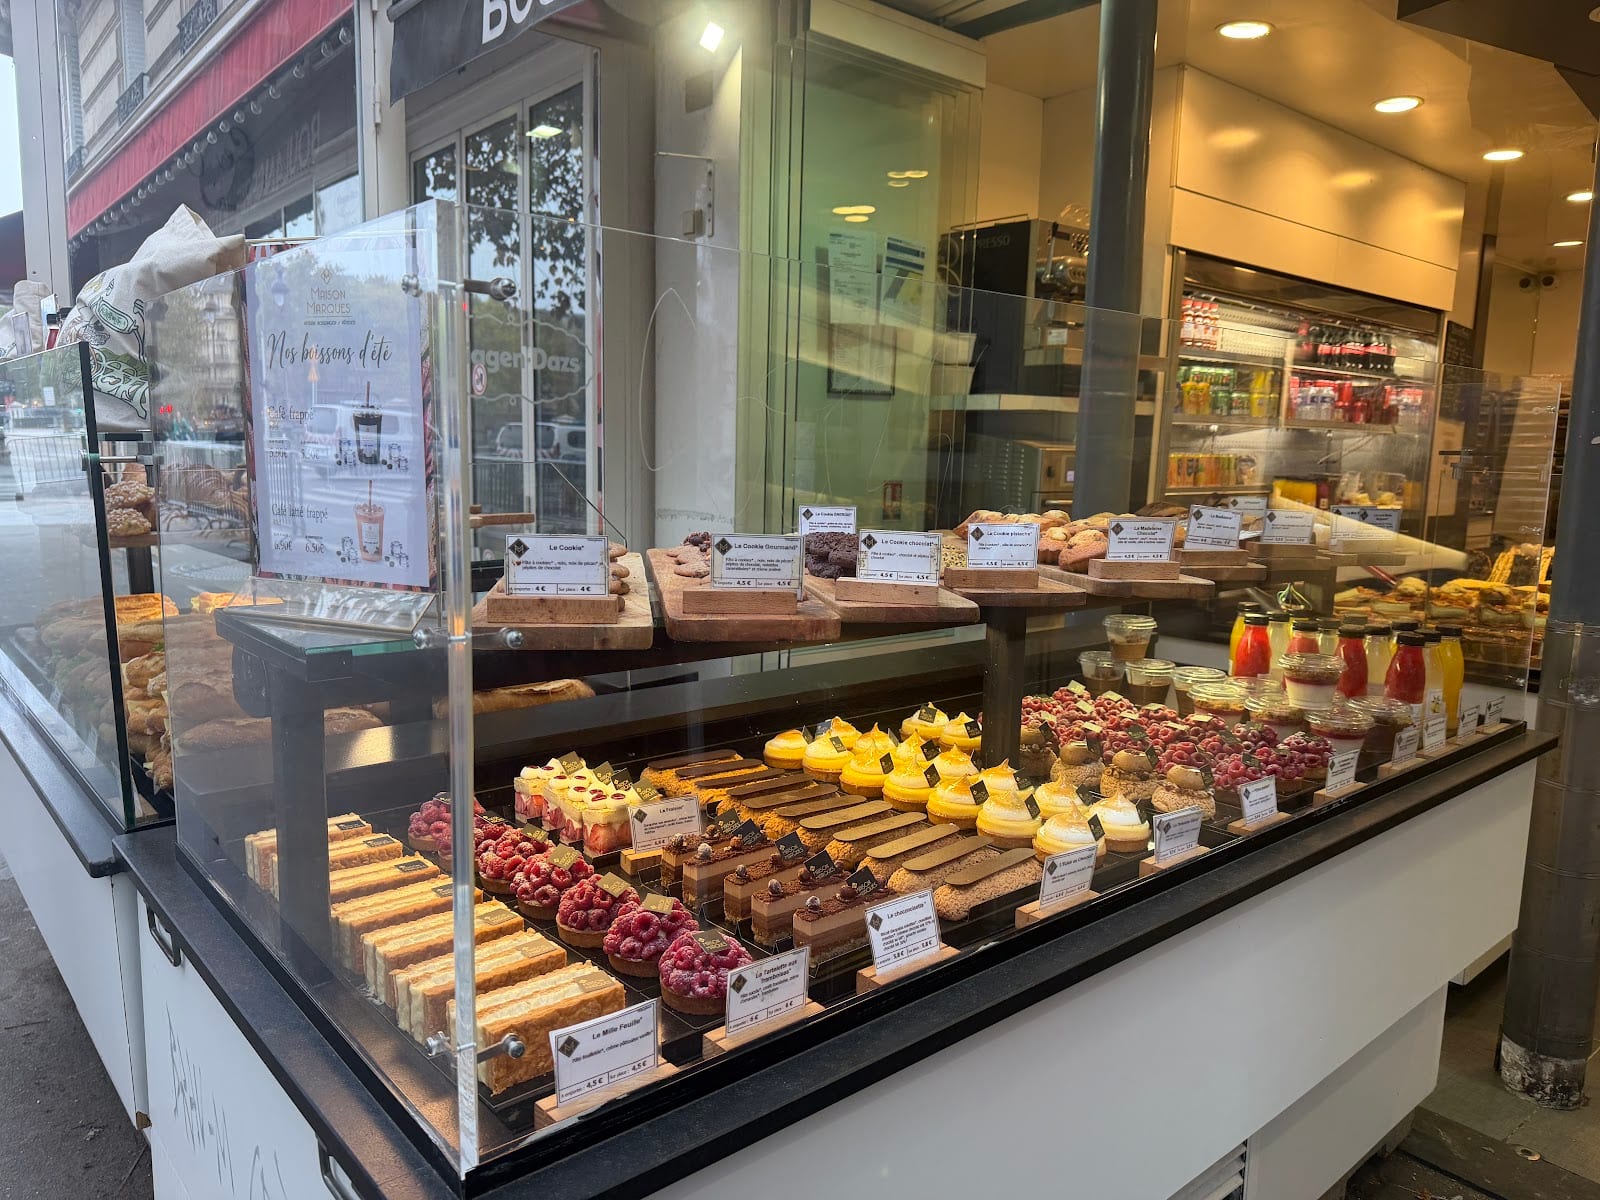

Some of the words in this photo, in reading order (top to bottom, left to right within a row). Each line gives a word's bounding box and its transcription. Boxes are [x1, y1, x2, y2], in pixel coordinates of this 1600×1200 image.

[482, 0, 552, 44] BO
[267, 330, 298, 368] Nos
[301, 332, 355, 364] boissons
[359, 329, 393, 368] d'été
[762, 963, 788, 975] Tartelette
[592, 1032, 601, 1040] Le
[601, 1027, 619, 1037] Mille
[631, 1062, 643, 1072] 4,5
[586, 1079, 598, 1089] 4,5
